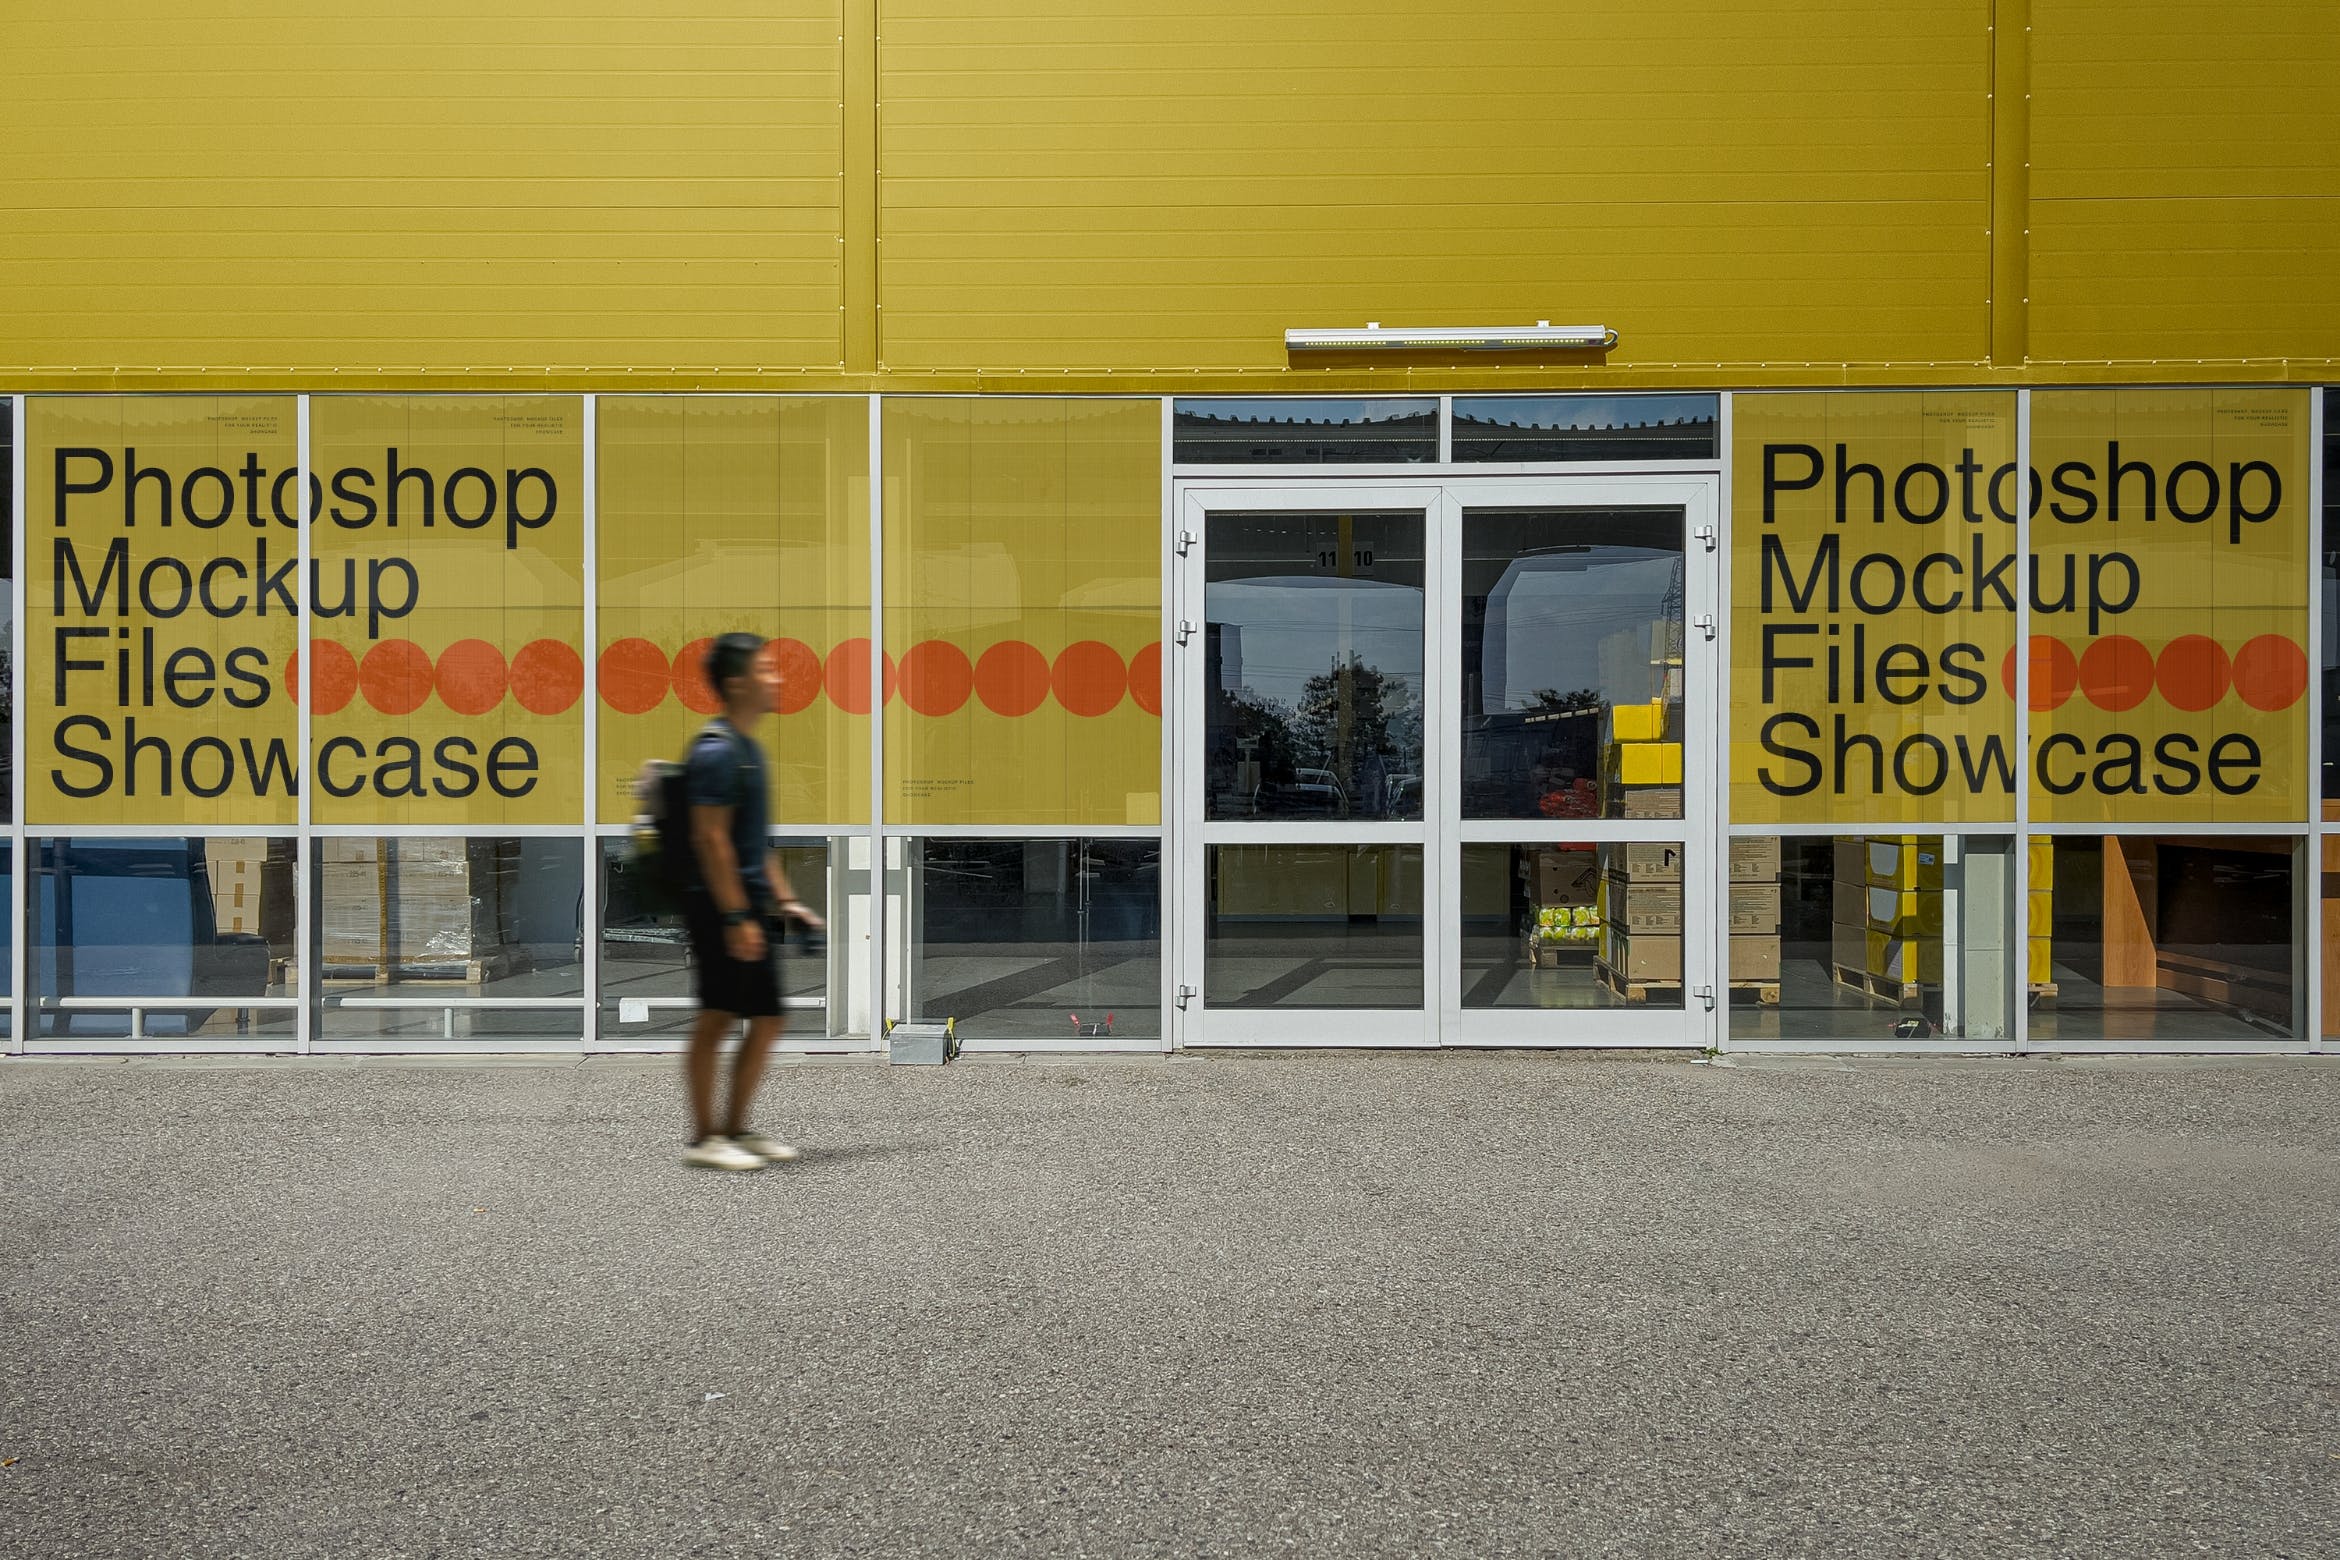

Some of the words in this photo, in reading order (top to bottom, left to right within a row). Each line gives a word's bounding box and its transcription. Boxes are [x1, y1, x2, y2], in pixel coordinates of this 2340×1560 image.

[54, 447, 558, 550] Photoshop
[1762, 441, 2283, 544] Photoshop
[54, 537, 419, 640] Mockup
[1318, 551, 1336, 567] 11
[1354, 551, 1373, 567] 10
[1760, 533, 2140, 636] Mockup
[54, 627, 271, 708] Files
[1761, 623, 1988, 706] Files
[51, 714, 539, 798] Showcase
[1757, 711, 2262, 796] Showcase
